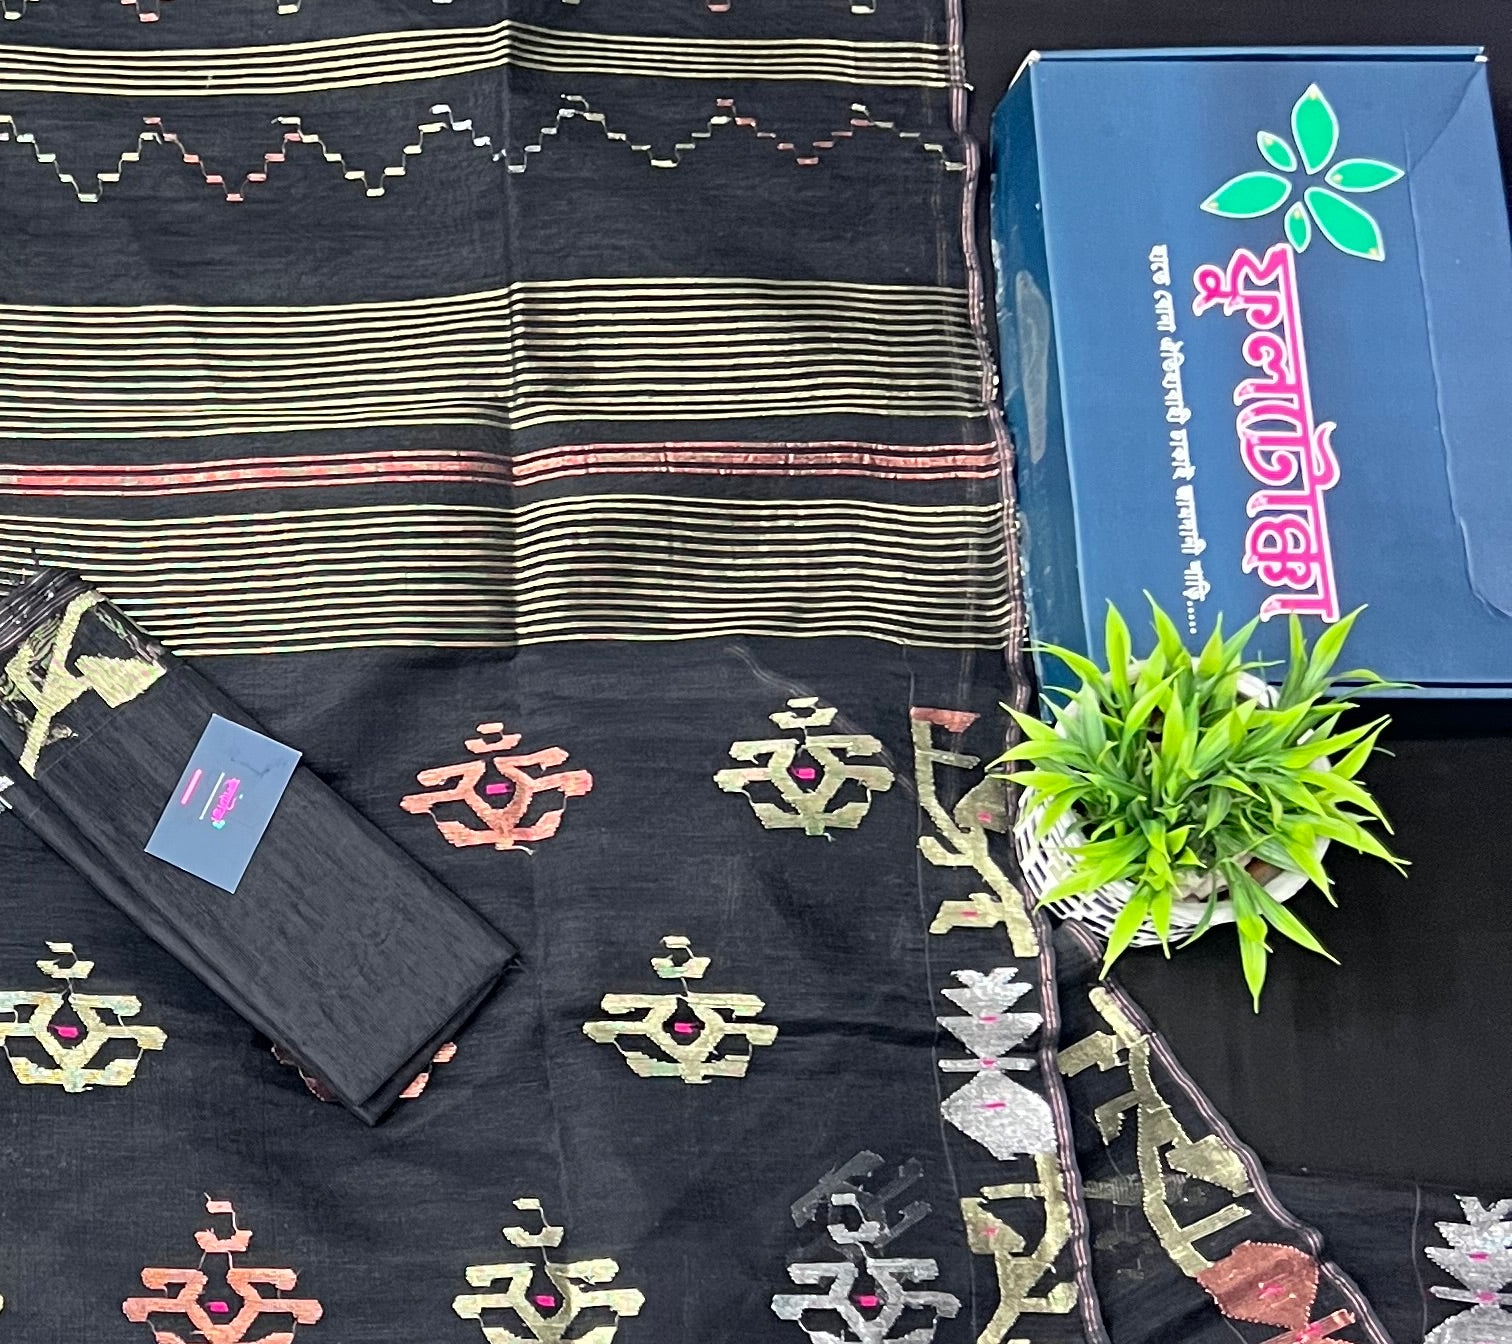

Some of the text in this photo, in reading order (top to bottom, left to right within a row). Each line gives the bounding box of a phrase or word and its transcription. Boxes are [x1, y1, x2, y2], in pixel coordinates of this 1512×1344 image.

[1148, 243, 1172, 286] হাতে
[1153, 289, 1177, 333] বোনা
[1169, 428, 1197, 481] ঢাকাই
[1193, 243, 1341, 623] ফুলটোক্কা
